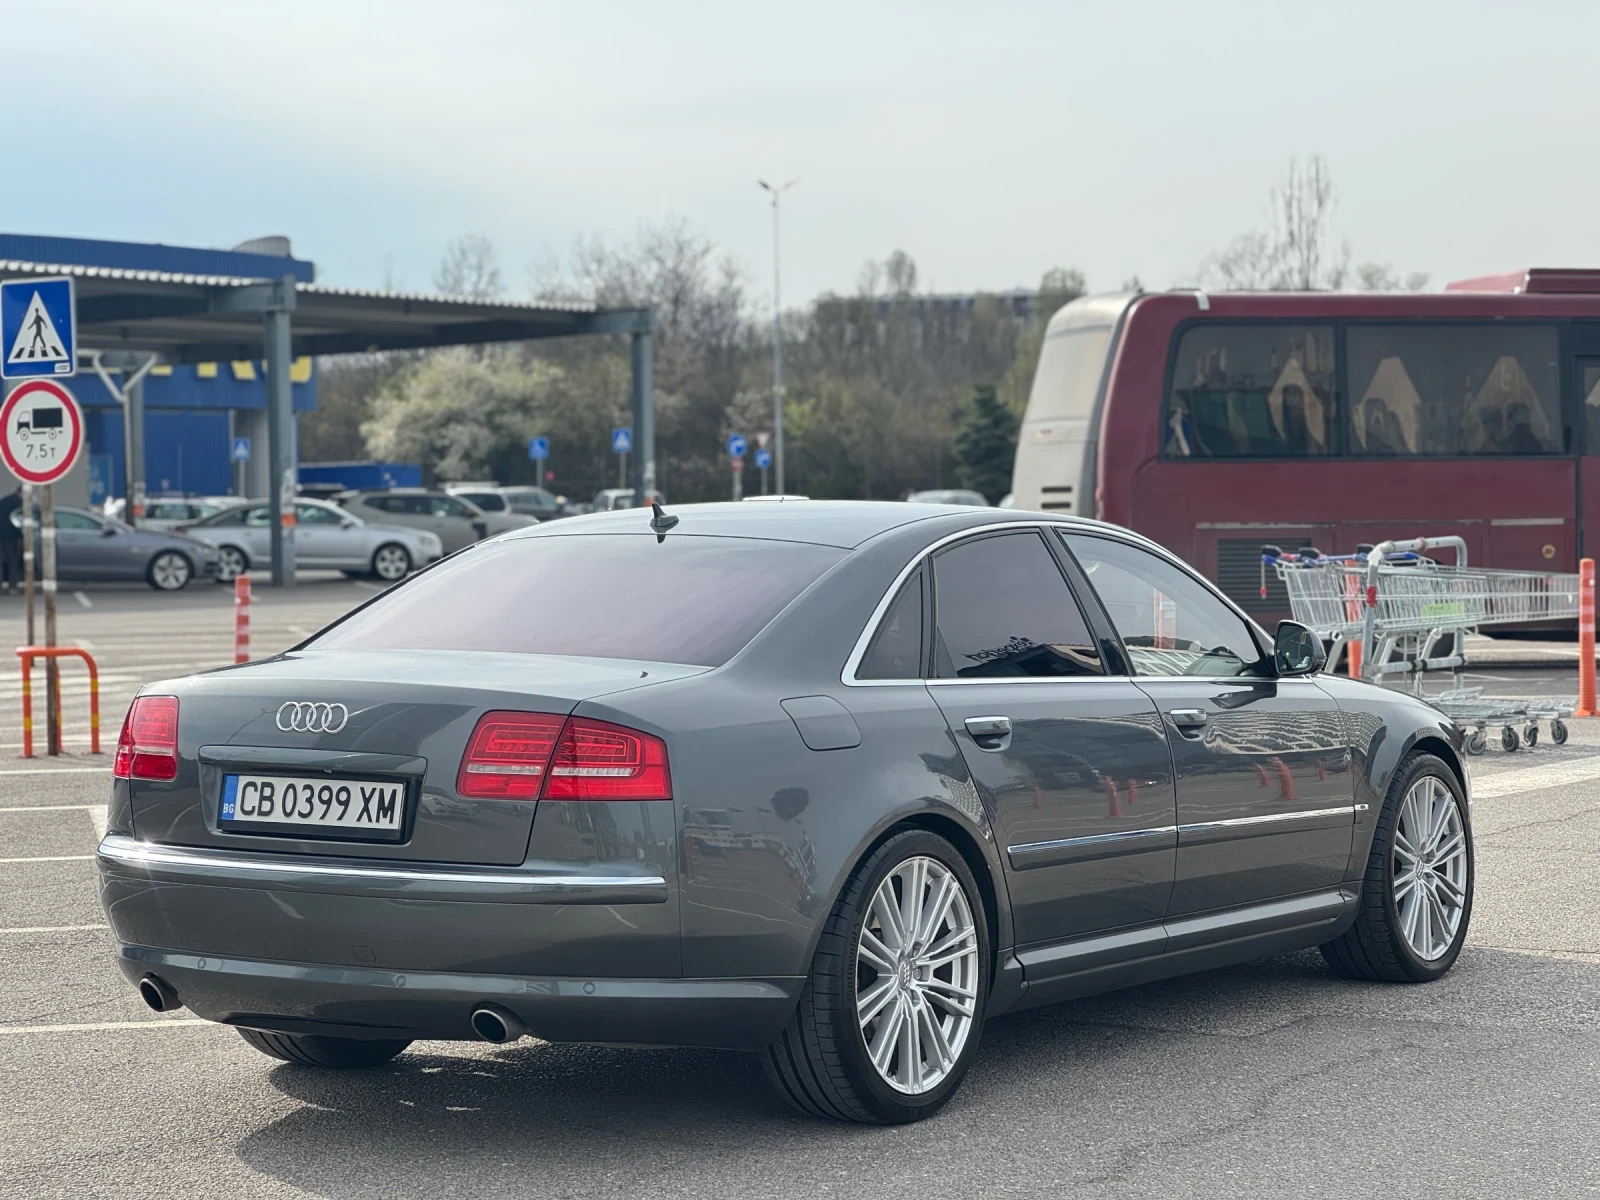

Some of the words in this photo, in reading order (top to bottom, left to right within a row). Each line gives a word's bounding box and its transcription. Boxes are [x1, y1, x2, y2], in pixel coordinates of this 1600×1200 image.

[223, 803, 234, 814] BG
[239, 781, 275, 817] CB
[281, 783, 351, 821] 0399
[356, 786, 397, 824] XM
